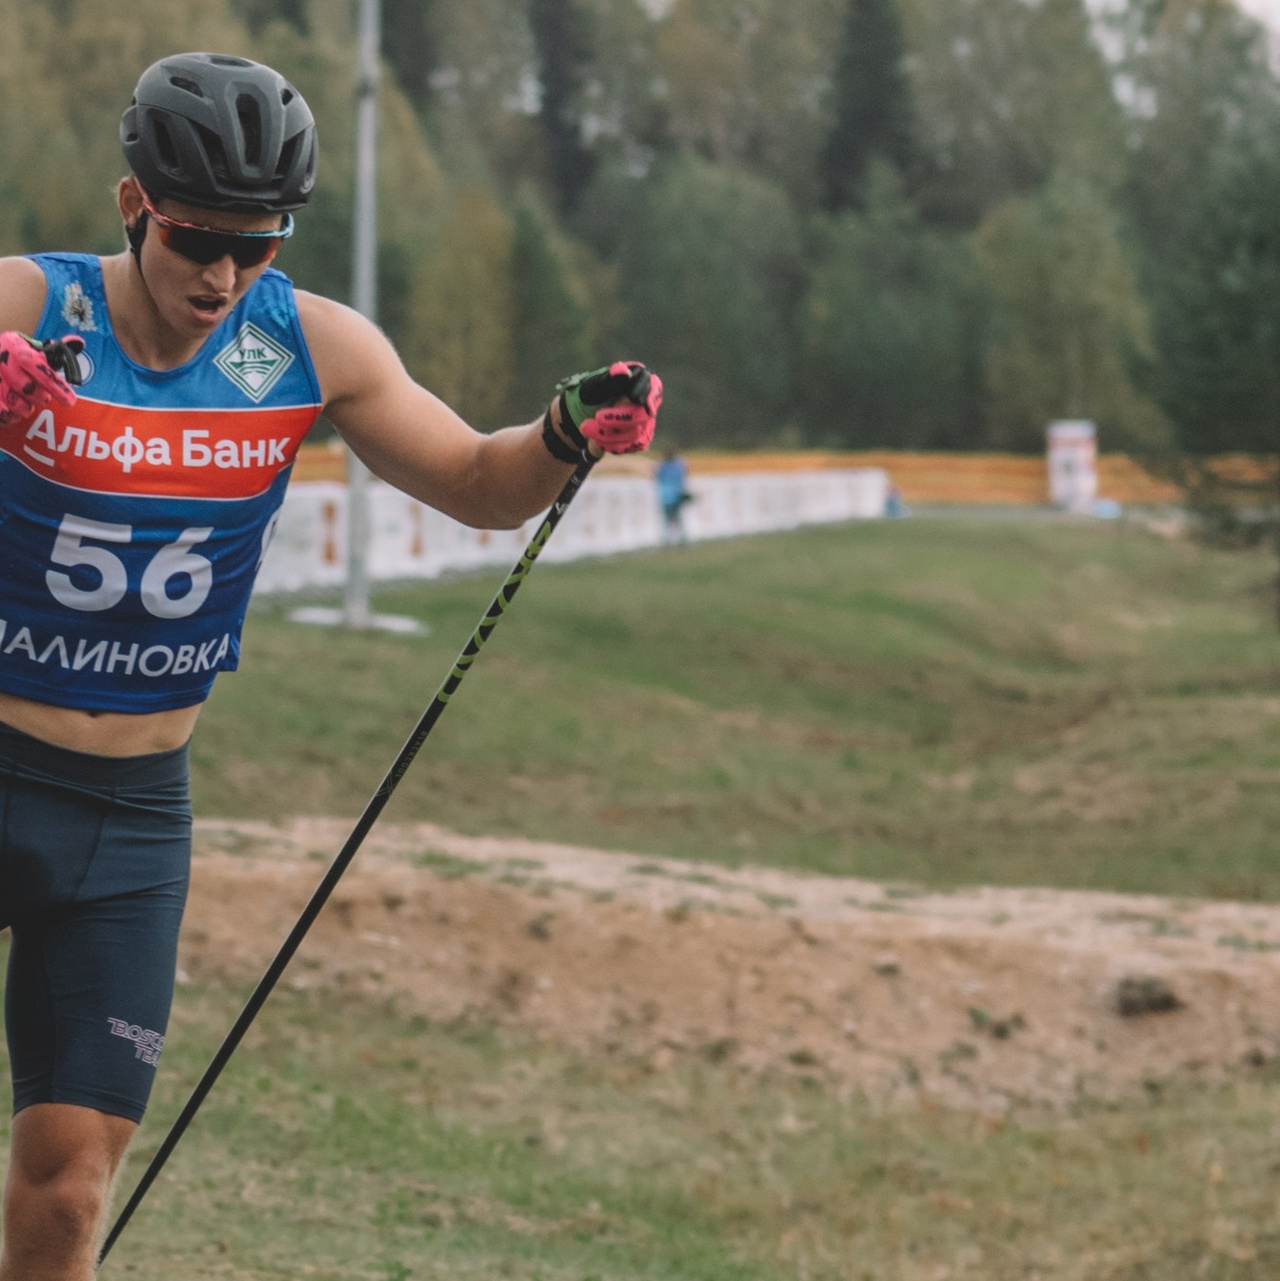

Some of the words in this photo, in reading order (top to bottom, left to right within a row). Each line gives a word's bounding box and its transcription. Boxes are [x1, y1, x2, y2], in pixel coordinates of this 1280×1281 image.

[239, 347, 267, 360] УЛК
[25, 409, 171, 473] Альфа
[182, 429, 291, 469] Банк
[45, 513, 214, 619] 56
